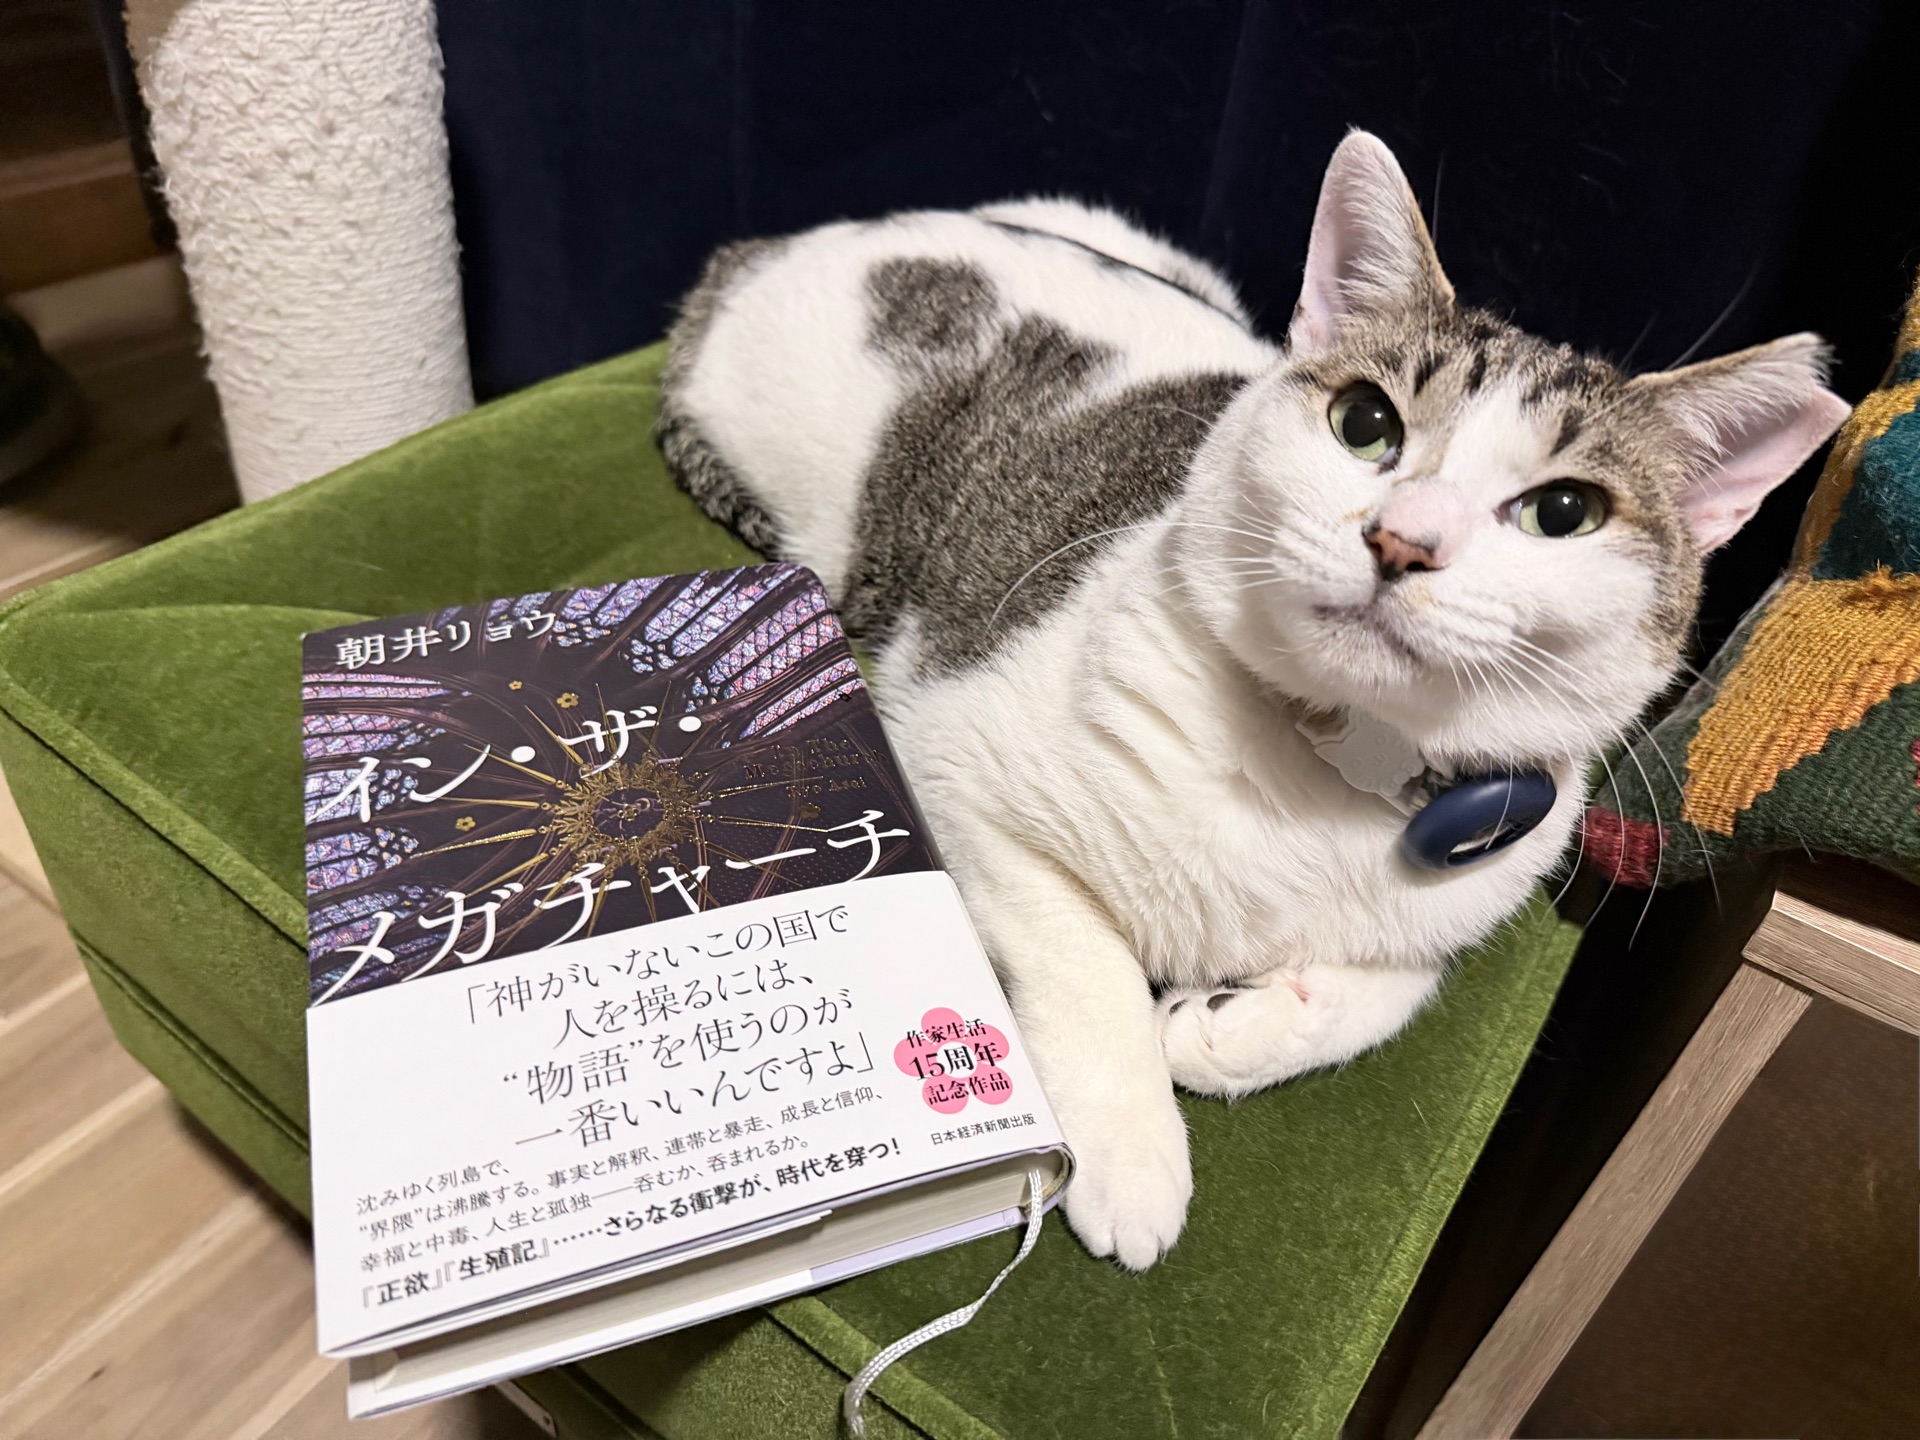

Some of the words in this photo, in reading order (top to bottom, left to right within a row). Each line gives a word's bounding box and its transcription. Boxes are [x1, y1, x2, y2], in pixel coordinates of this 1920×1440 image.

[336, 610, 556, 670] 朝井リョウ
[307, 705, 702, 823] イン・ザ・
[310, 810, 910, 1007] メガチャーチ
[468, 905, 849, 1024] 「神がいないこの国で
[552, 959, 814, 1050] 人を操るには、
[906, 1018, 987, 1049] 作家生活
[515, 1031, 875, 1148] 一番いいんですよ」
[909, 1042, 1003, 1081] 15周年
[925, 1072, 1010, 1105] 記念作品
[930, 1113, 1037, 1146] 日本経済新聞出版
[357, 1159, 510, 1215] 沈みゆく列島で、
